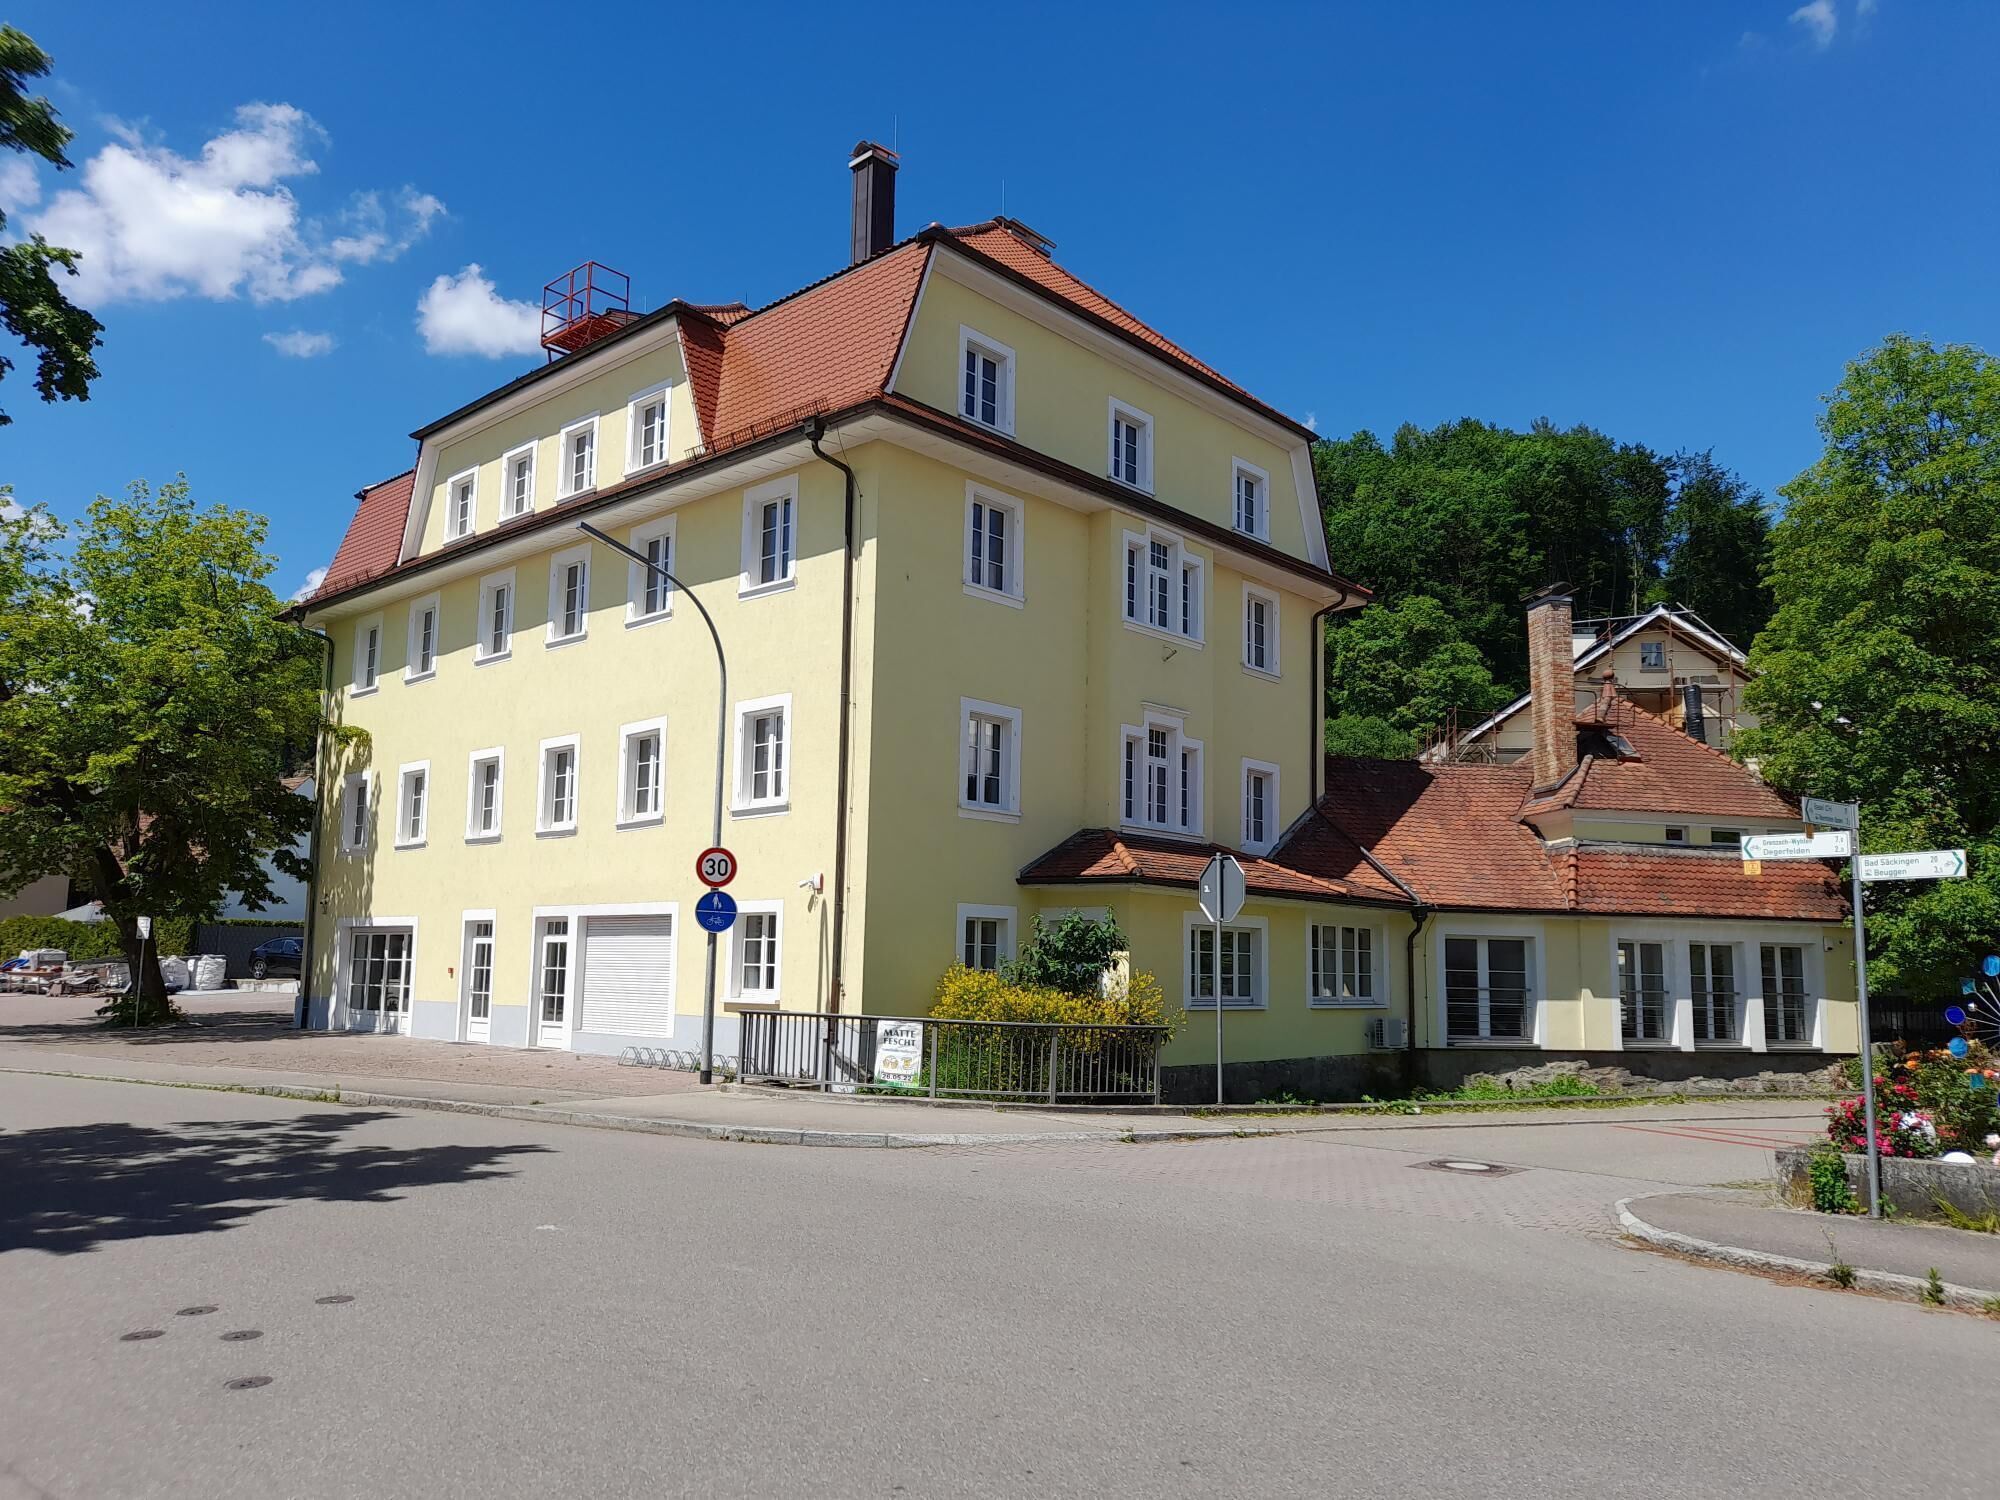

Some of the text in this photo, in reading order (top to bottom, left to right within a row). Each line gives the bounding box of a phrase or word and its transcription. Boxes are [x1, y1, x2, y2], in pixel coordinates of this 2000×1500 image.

[1763, 847, 1811, 856] Degerfelden
[1864, 859, 1879, 867] Bad
[1880, 857, 1920, 866] Säckingen
[705, 858, 728, 877] 30
[1874, 868, 1907, 877] Beuggen
[883, 1029, 916, 1038] MATTE
[883, 1037, 916, 1046] FESCHT
